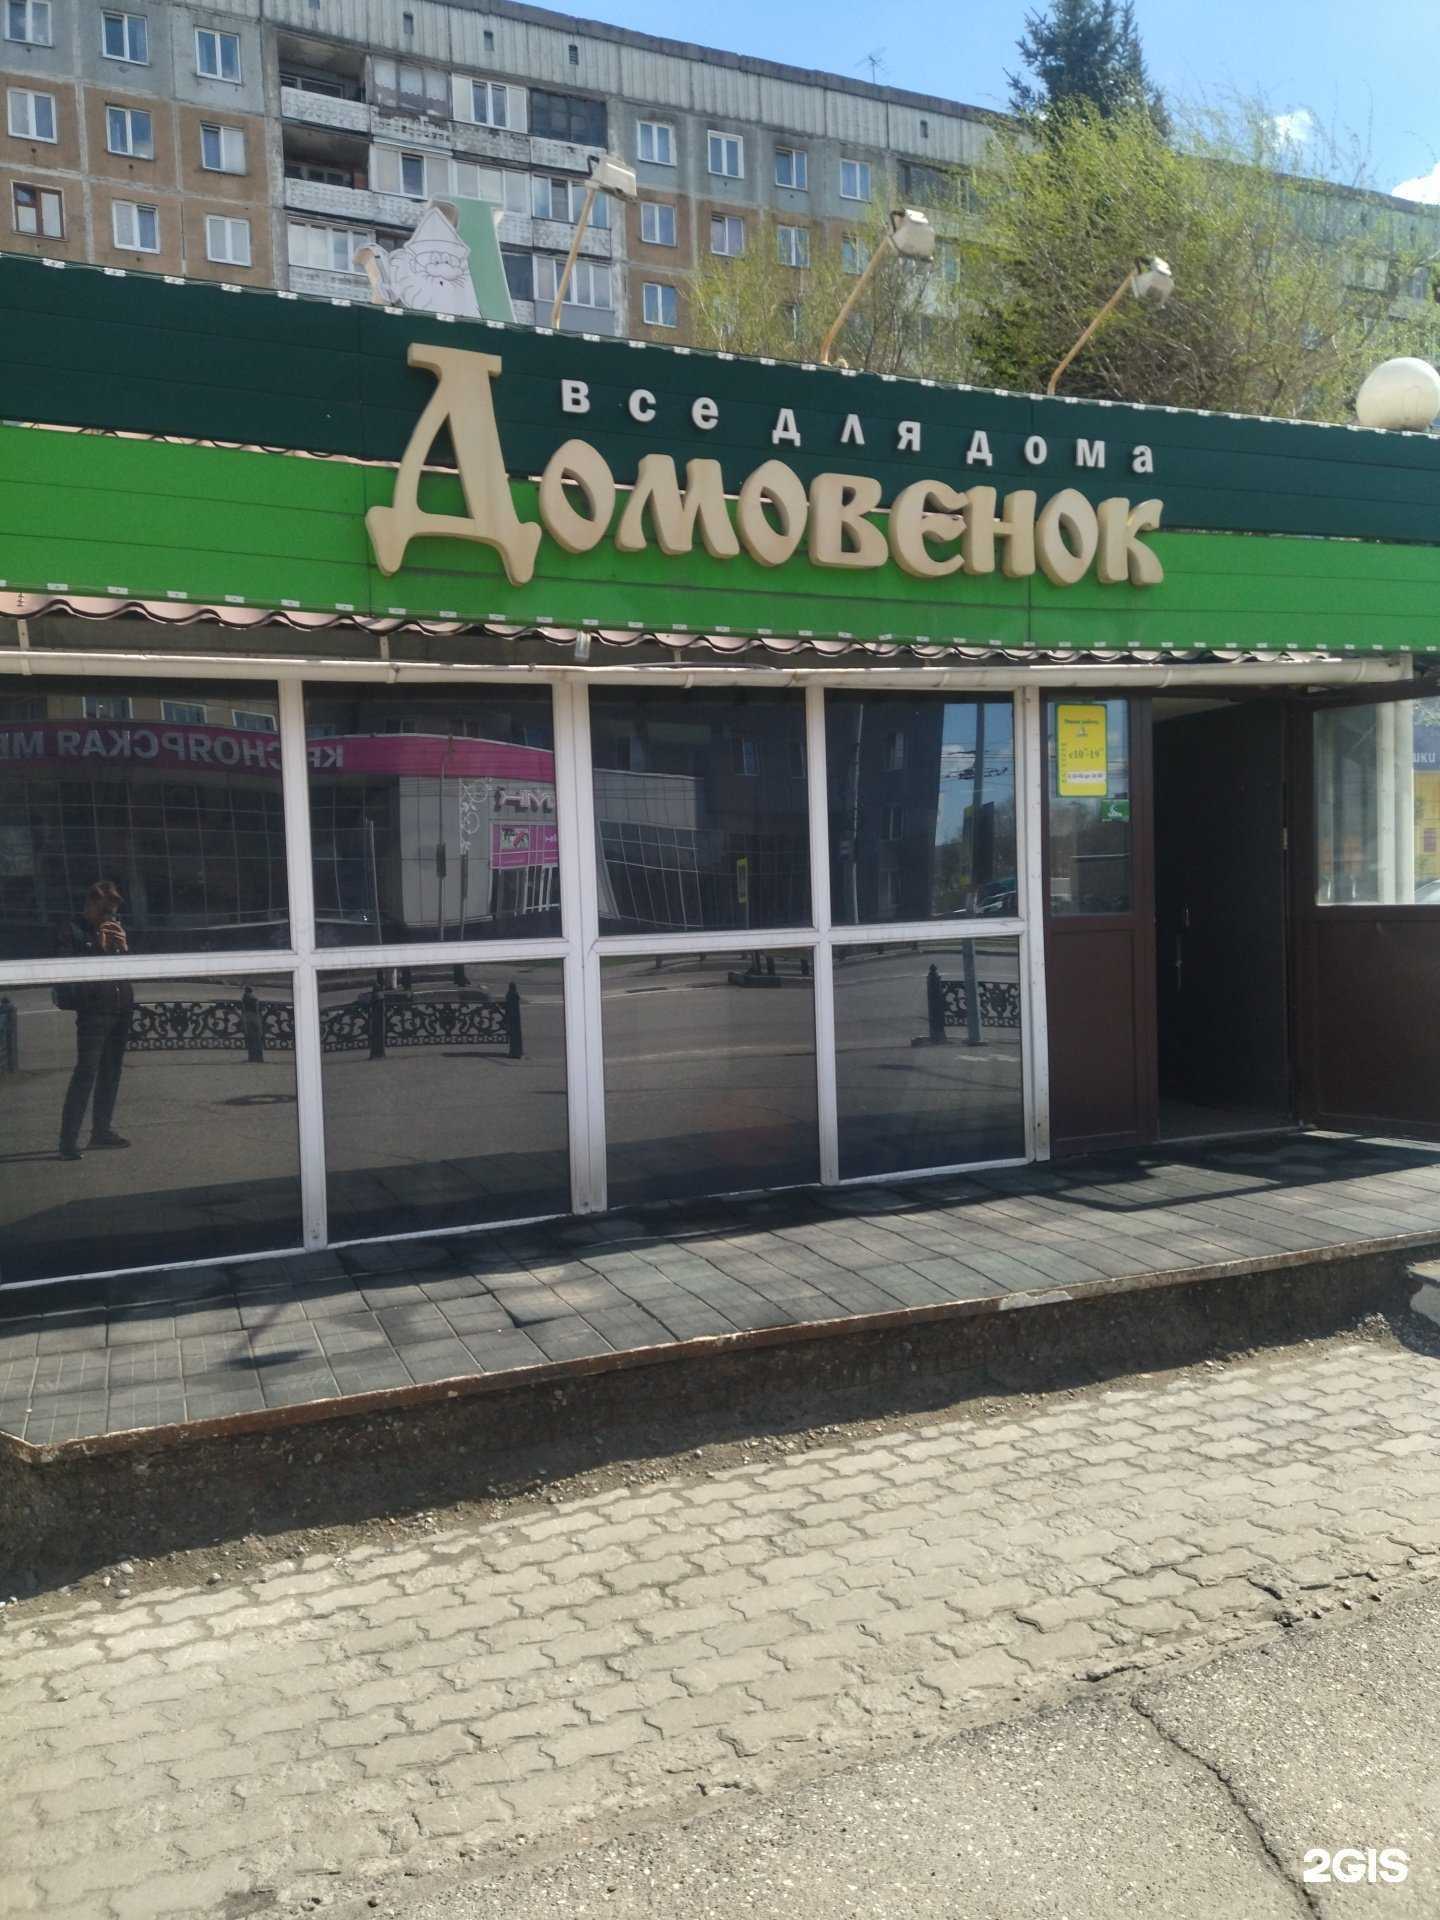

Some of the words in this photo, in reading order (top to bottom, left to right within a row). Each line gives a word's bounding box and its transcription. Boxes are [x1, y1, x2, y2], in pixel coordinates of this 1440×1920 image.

[561, 379, 719, 430] все
[772, 408, 921, 452] для
[966, 420, 1153, 474] дома
